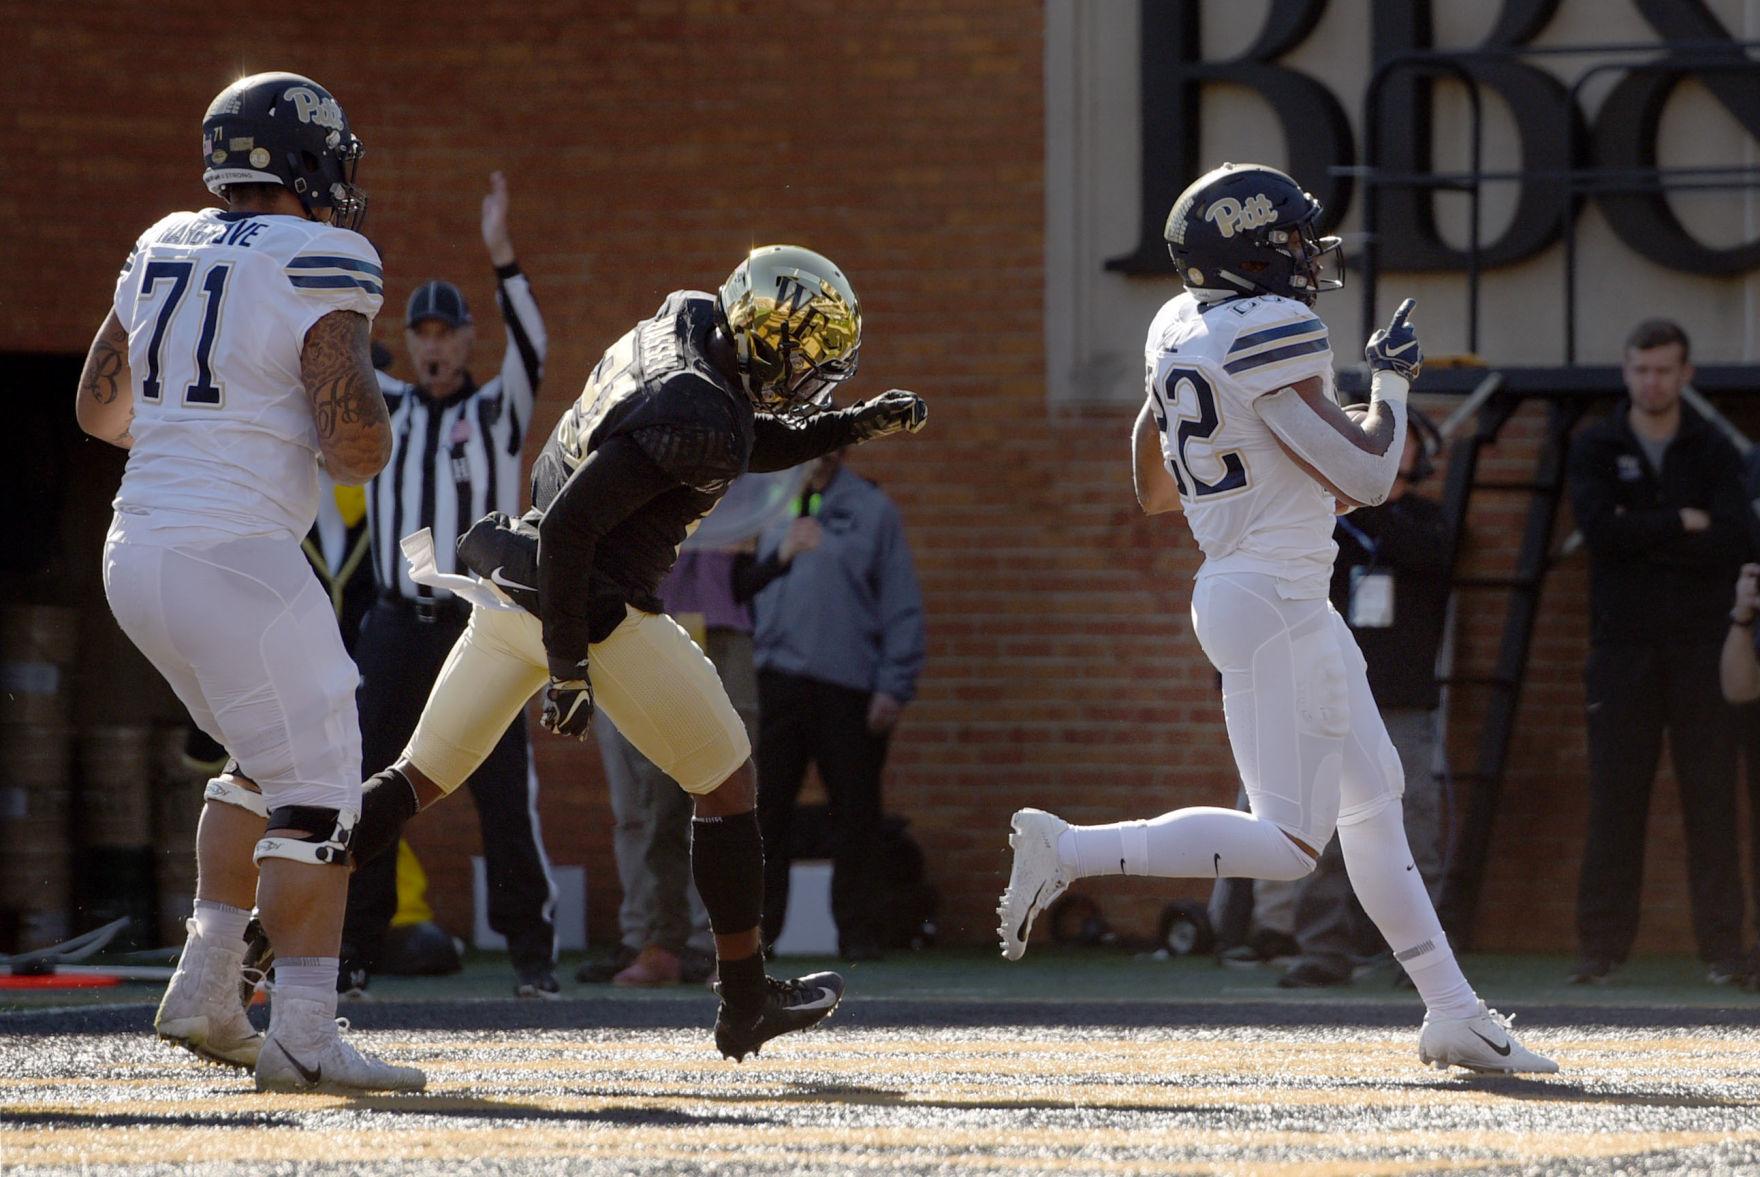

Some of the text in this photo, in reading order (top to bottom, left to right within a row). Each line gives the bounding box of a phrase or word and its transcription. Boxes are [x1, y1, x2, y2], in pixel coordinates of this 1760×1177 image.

[283, 87, 345, 131] Pitt
[1205, 193, 1279, 239] Pitt
[137, 256, 236, 410] 71
